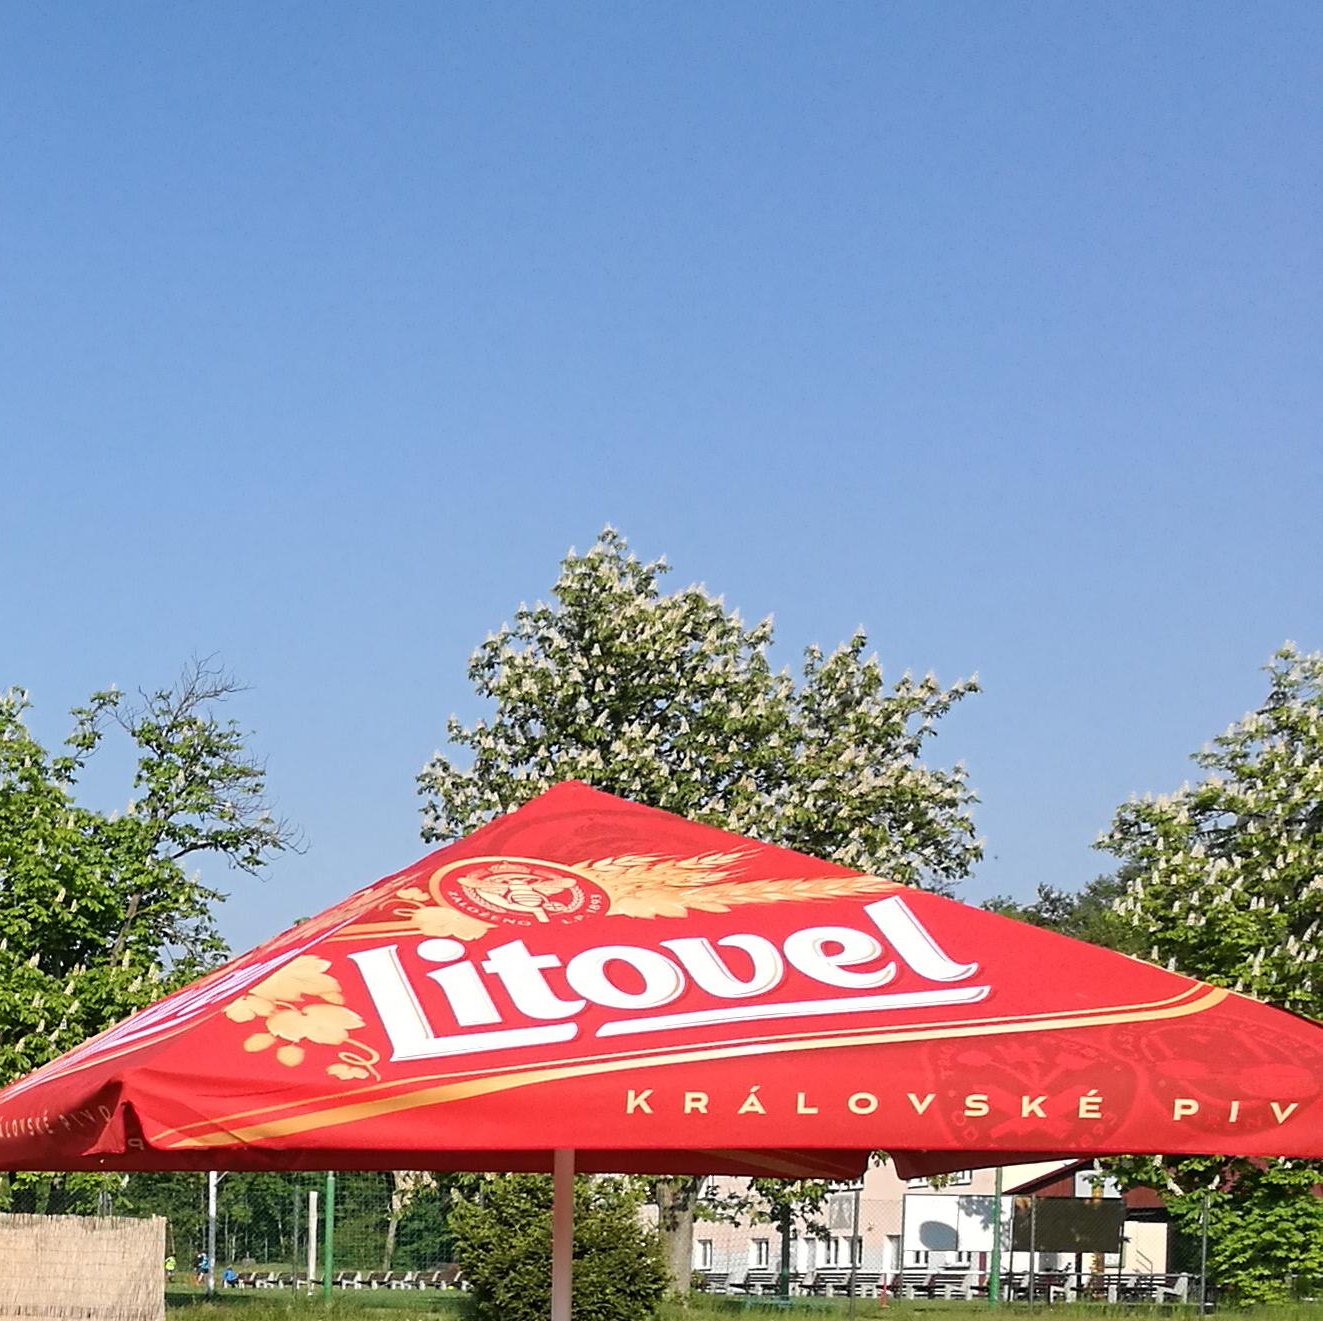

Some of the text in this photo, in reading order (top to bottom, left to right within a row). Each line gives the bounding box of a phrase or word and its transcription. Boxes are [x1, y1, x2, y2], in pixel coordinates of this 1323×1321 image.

[347, 895, 980, 1062] Litovel
[625, 1085, 1299, 1125] KRÁLOVSKÉ PIV
